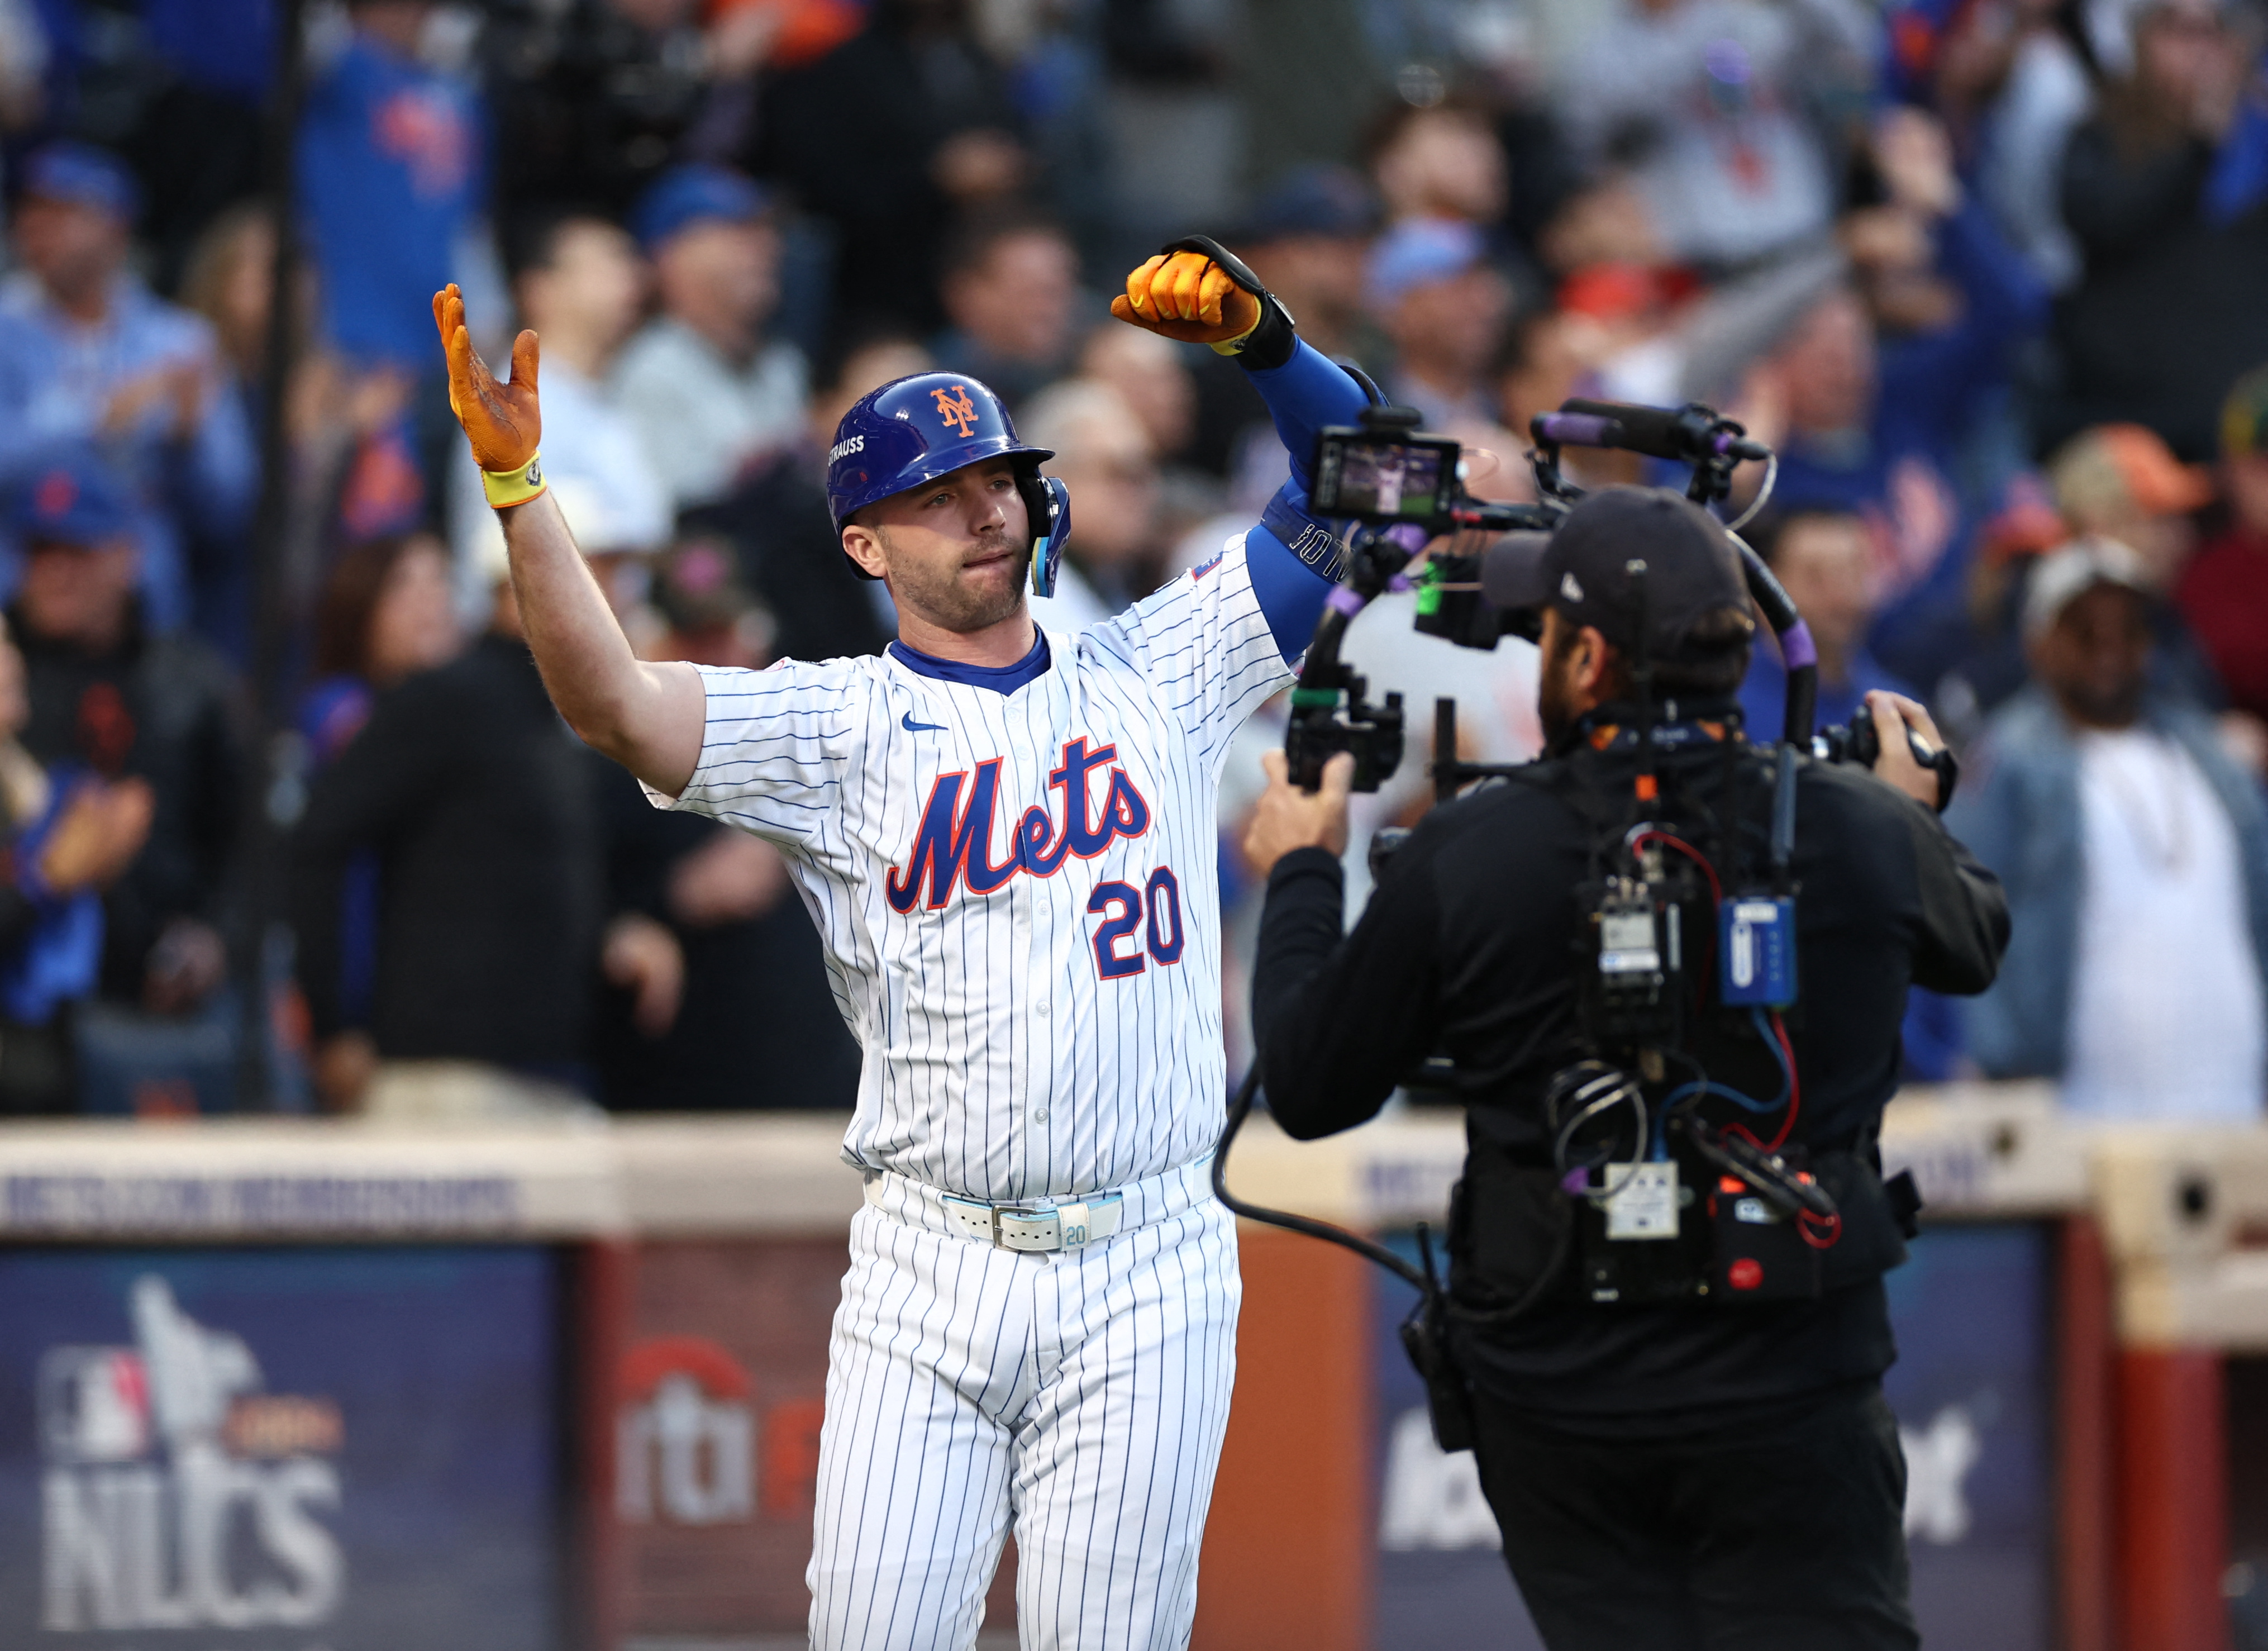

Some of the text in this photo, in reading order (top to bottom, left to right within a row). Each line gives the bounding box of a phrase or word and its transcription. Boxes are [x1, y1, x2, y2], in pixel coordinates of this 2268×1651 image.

[828, 435, 864, 467] STRAUSS
[930, 386, 979, 438] NY
[885, 735, 1150, 915] Mets
[1087, 865, 1185, 981] 20
[1066, 1225, 1085, 1246] 20
[39, 1454, 346, 1631] NLCS
